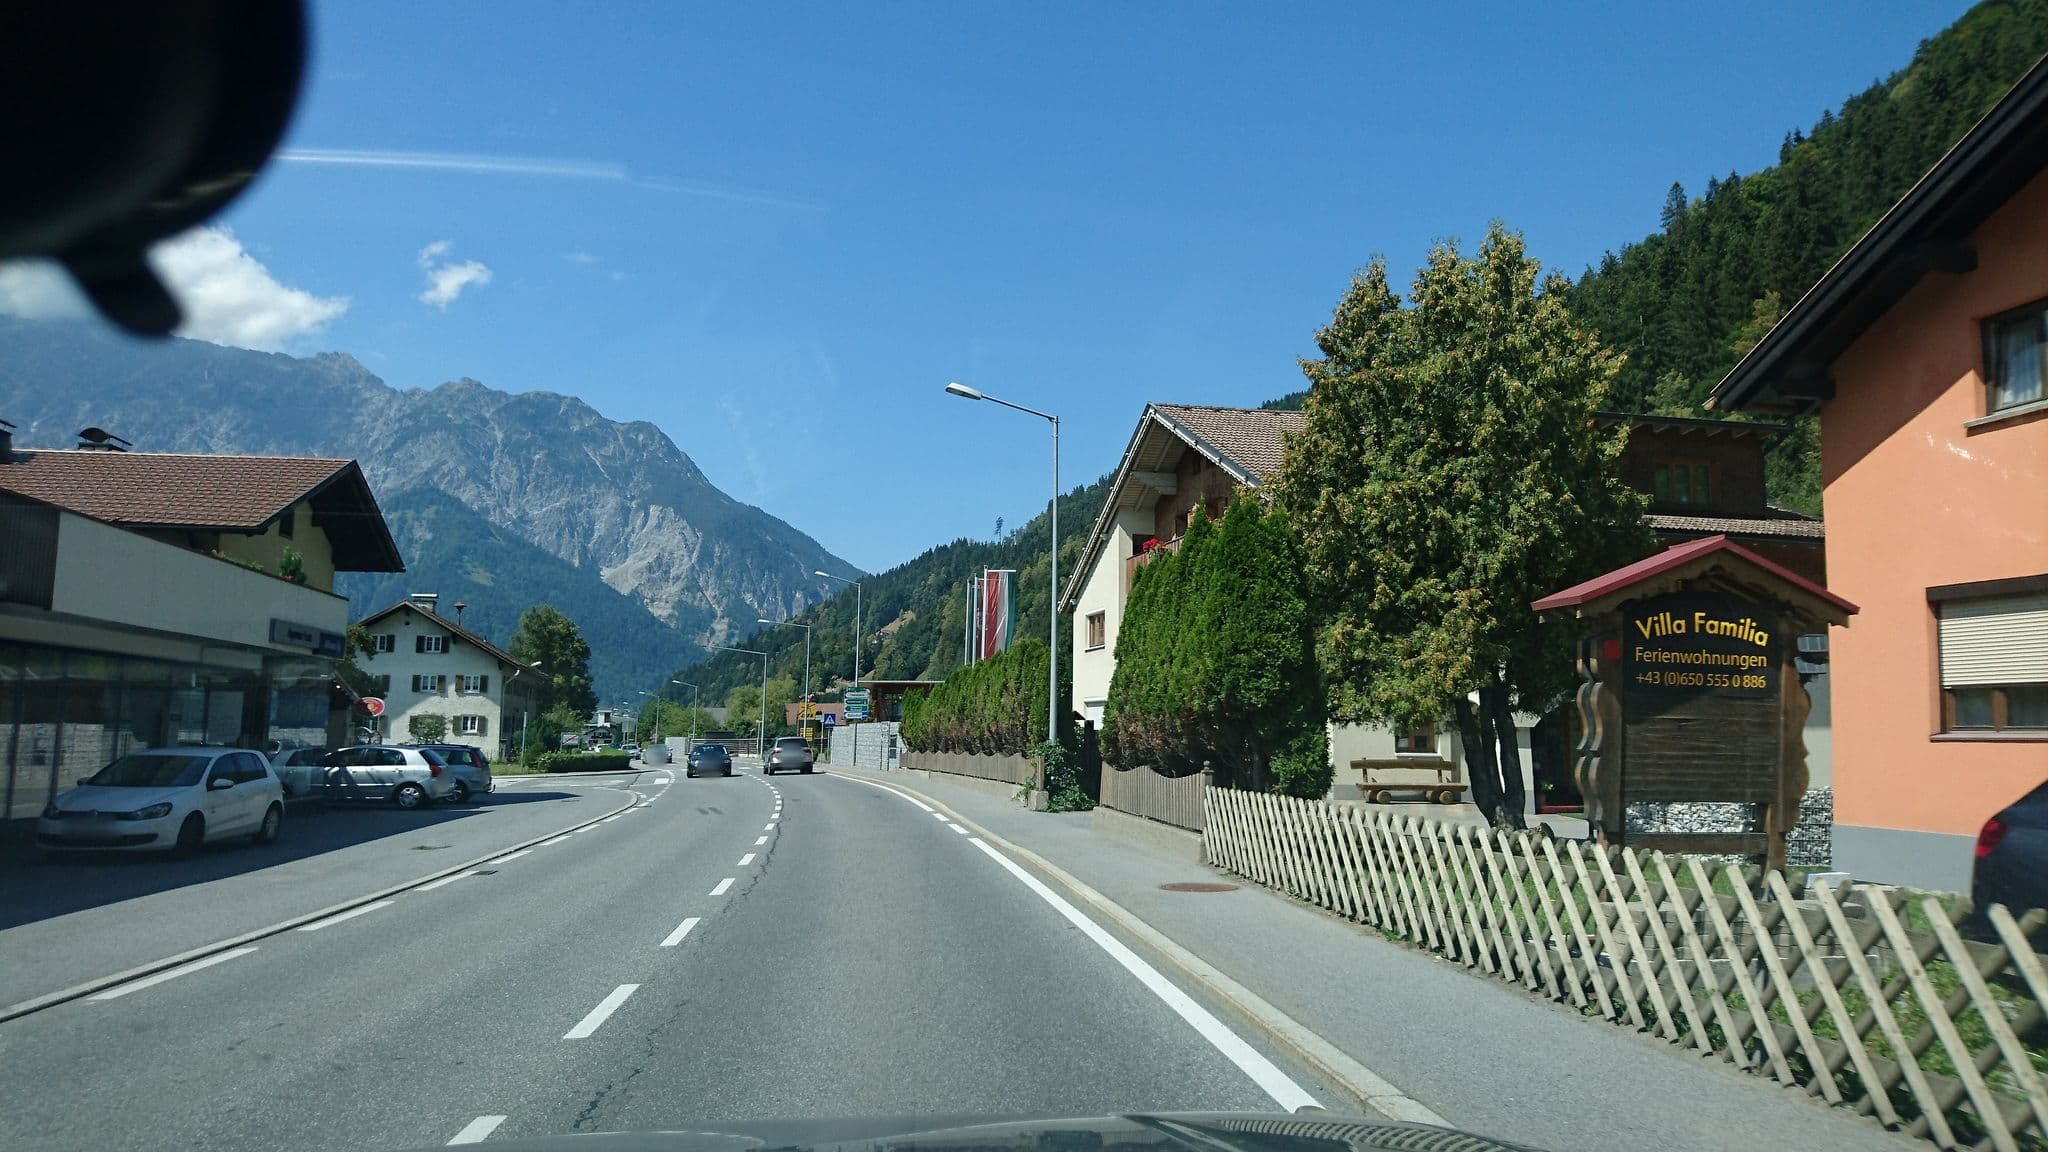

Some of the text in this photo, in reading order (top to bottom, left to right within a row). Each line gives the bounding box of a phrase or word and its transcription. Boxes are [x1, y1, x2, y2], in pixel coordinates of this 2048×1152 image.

[1635, 612, 1769, 646] Villa Familia
[1635, 647, 1767, 670] Ferienwohnungen
[1636, 671, 1766, 688] +43 (0)650 555 0 886
